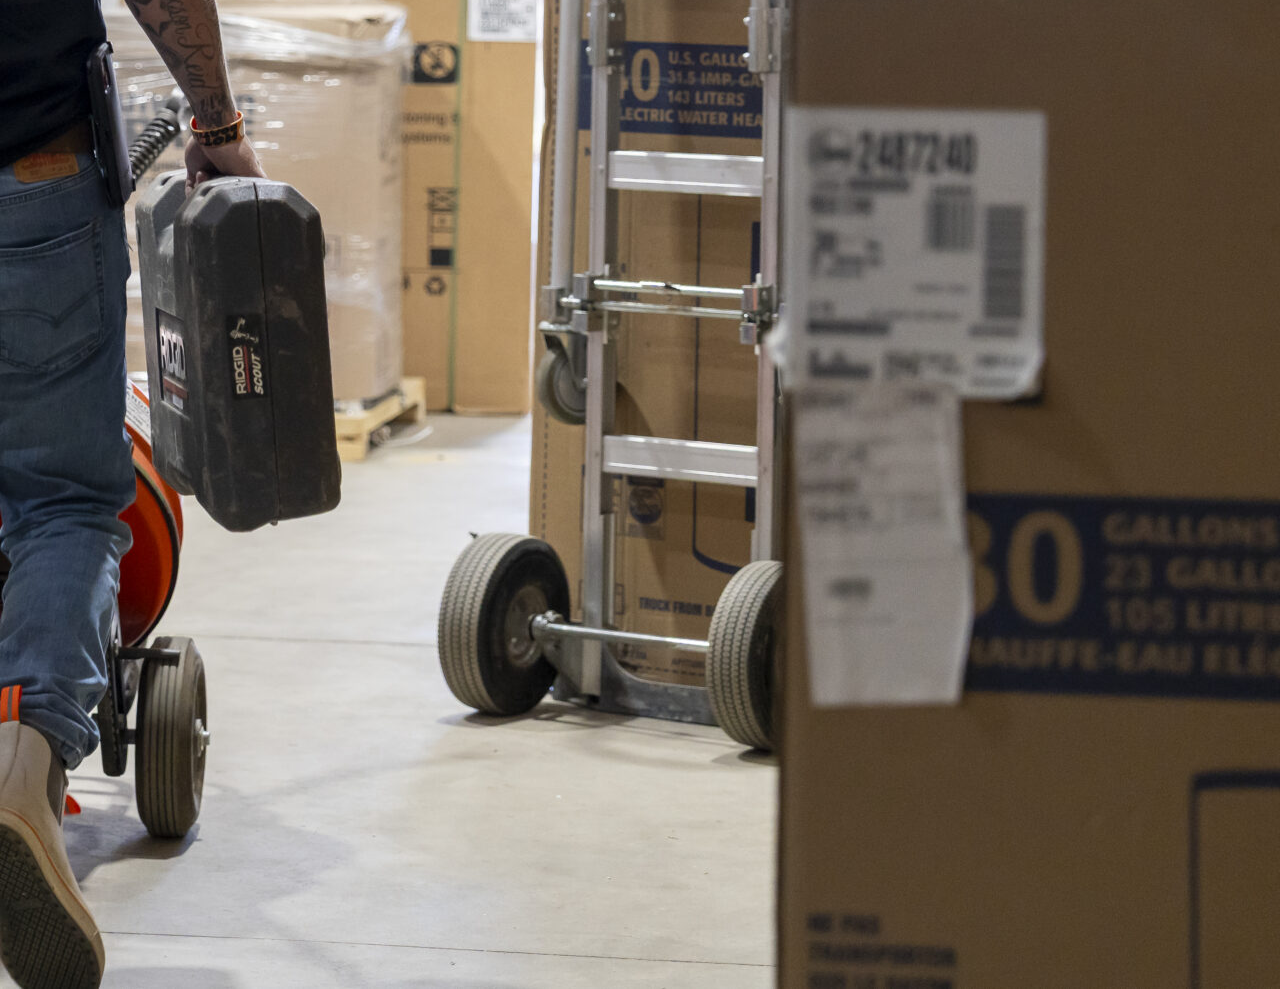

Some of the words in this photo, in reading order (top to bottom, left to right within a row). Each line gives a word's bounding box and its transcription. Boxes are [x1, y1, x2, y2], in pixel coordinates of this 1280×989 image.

[668, 51, 695, 66] U.S.
[668, 71, 695, 84] 31.5
[701, 72, 734, 86] IMP.
[668, 90, 690, 104] 143
[695, 91, 745, 107] LITERS
[678, 111, 728, 126] WATER
[232, 346, 247, 395] RIDGID
[251, 353, 264, 395] SCOUT
[639, 597, 669, 611] TRUCK
